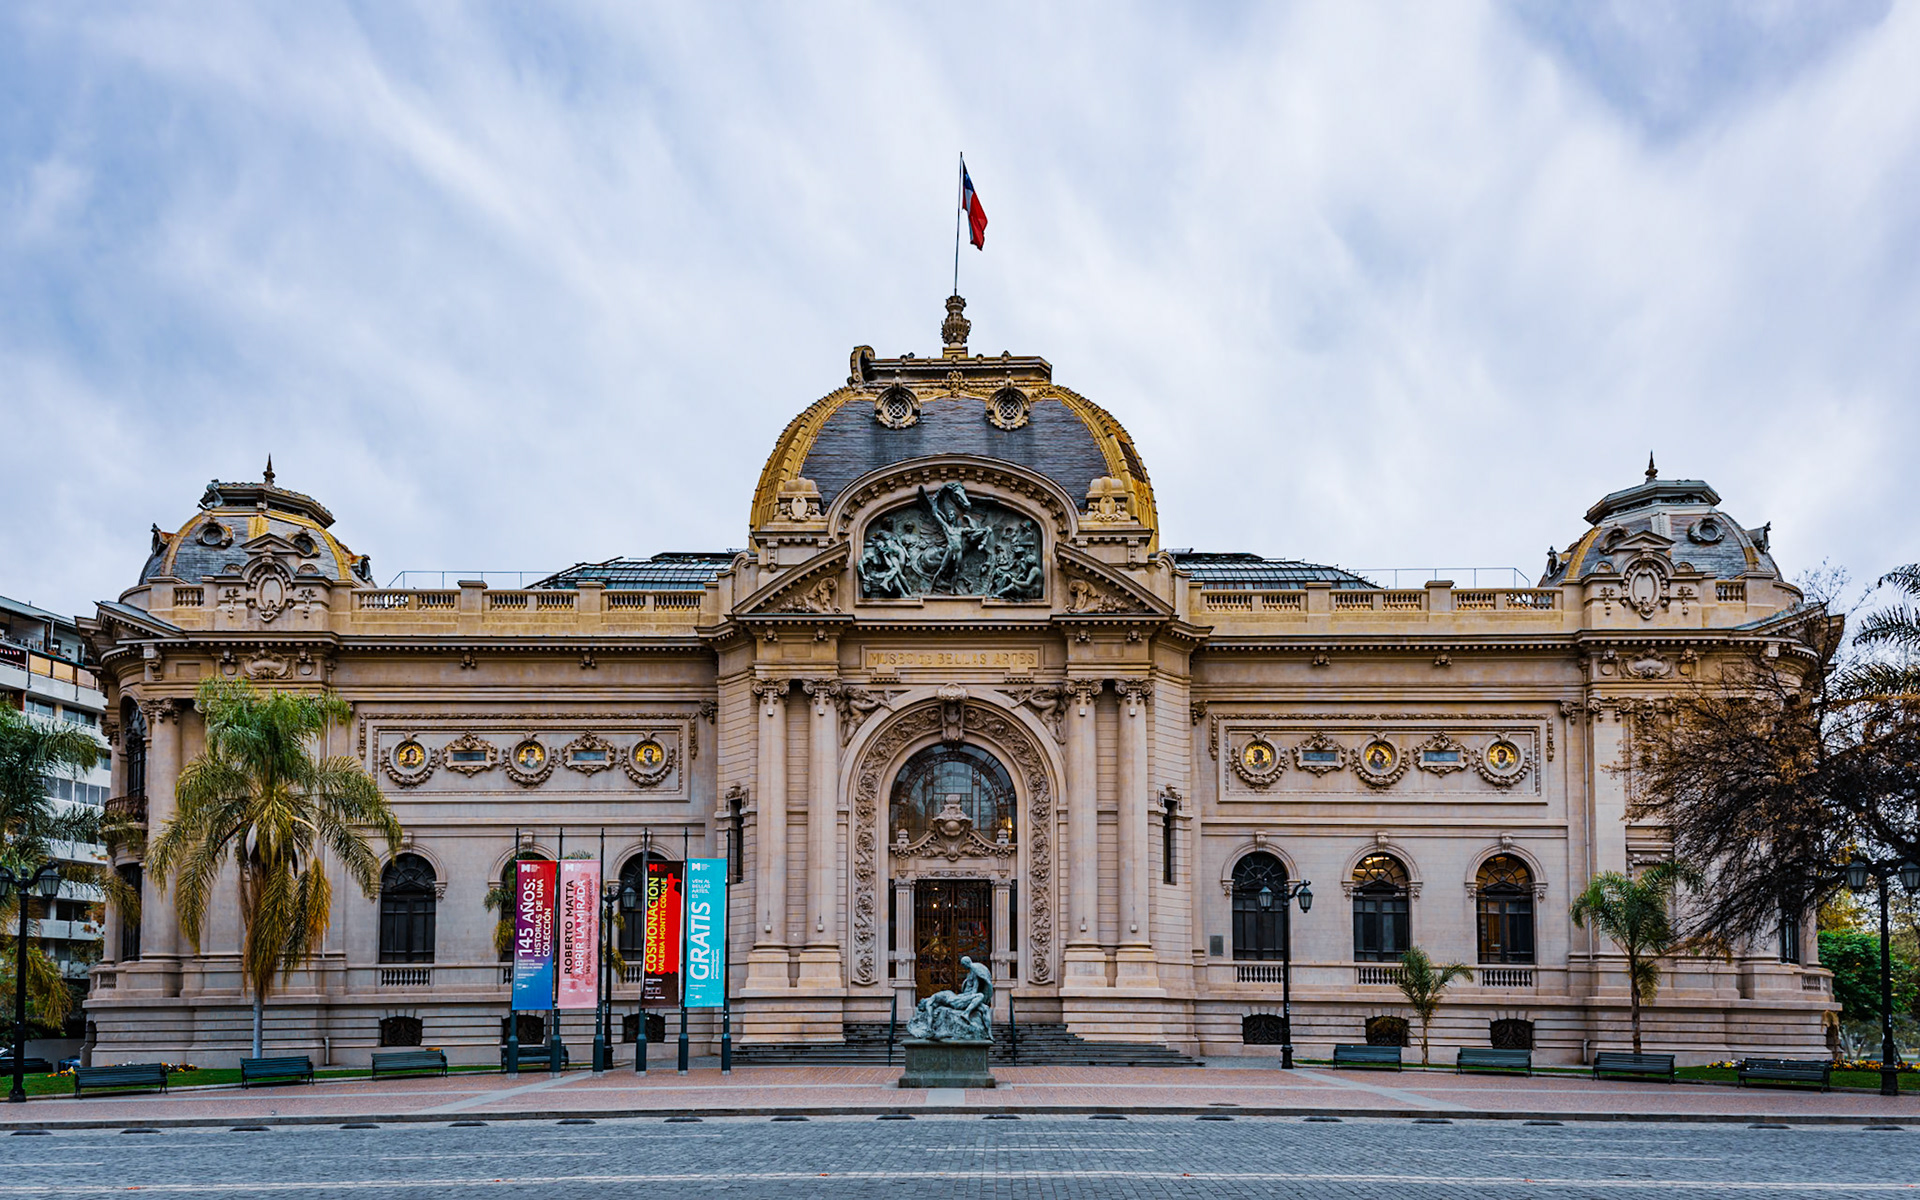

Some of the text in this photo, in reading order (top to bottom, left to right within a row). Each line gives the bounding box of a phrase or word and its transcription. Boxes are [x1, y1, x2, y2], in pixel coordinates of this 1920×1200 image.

[869, 653, 914, 665] MUSEO
[938, 653, 987, 665] BELLAS
[993, 653, 1036, 665] ARTES
[520, 879, 536, 923] AÑOS:
[534, 879, 544, 957] HISTORIAS DE UNA
[565, 880, 574, 918] MATTA
[576, 880, 586, 919] MIRADA
[519, 928, 534, 957] 145
[543, 908, 551, 957] COLECCIÓN
[564, 920, 574, 975] ROBERTO
[576, 923, 585, 939] LA
[690, 901, 711, 980] GRATIS
[574, 942, 584, 974] ABRIR
